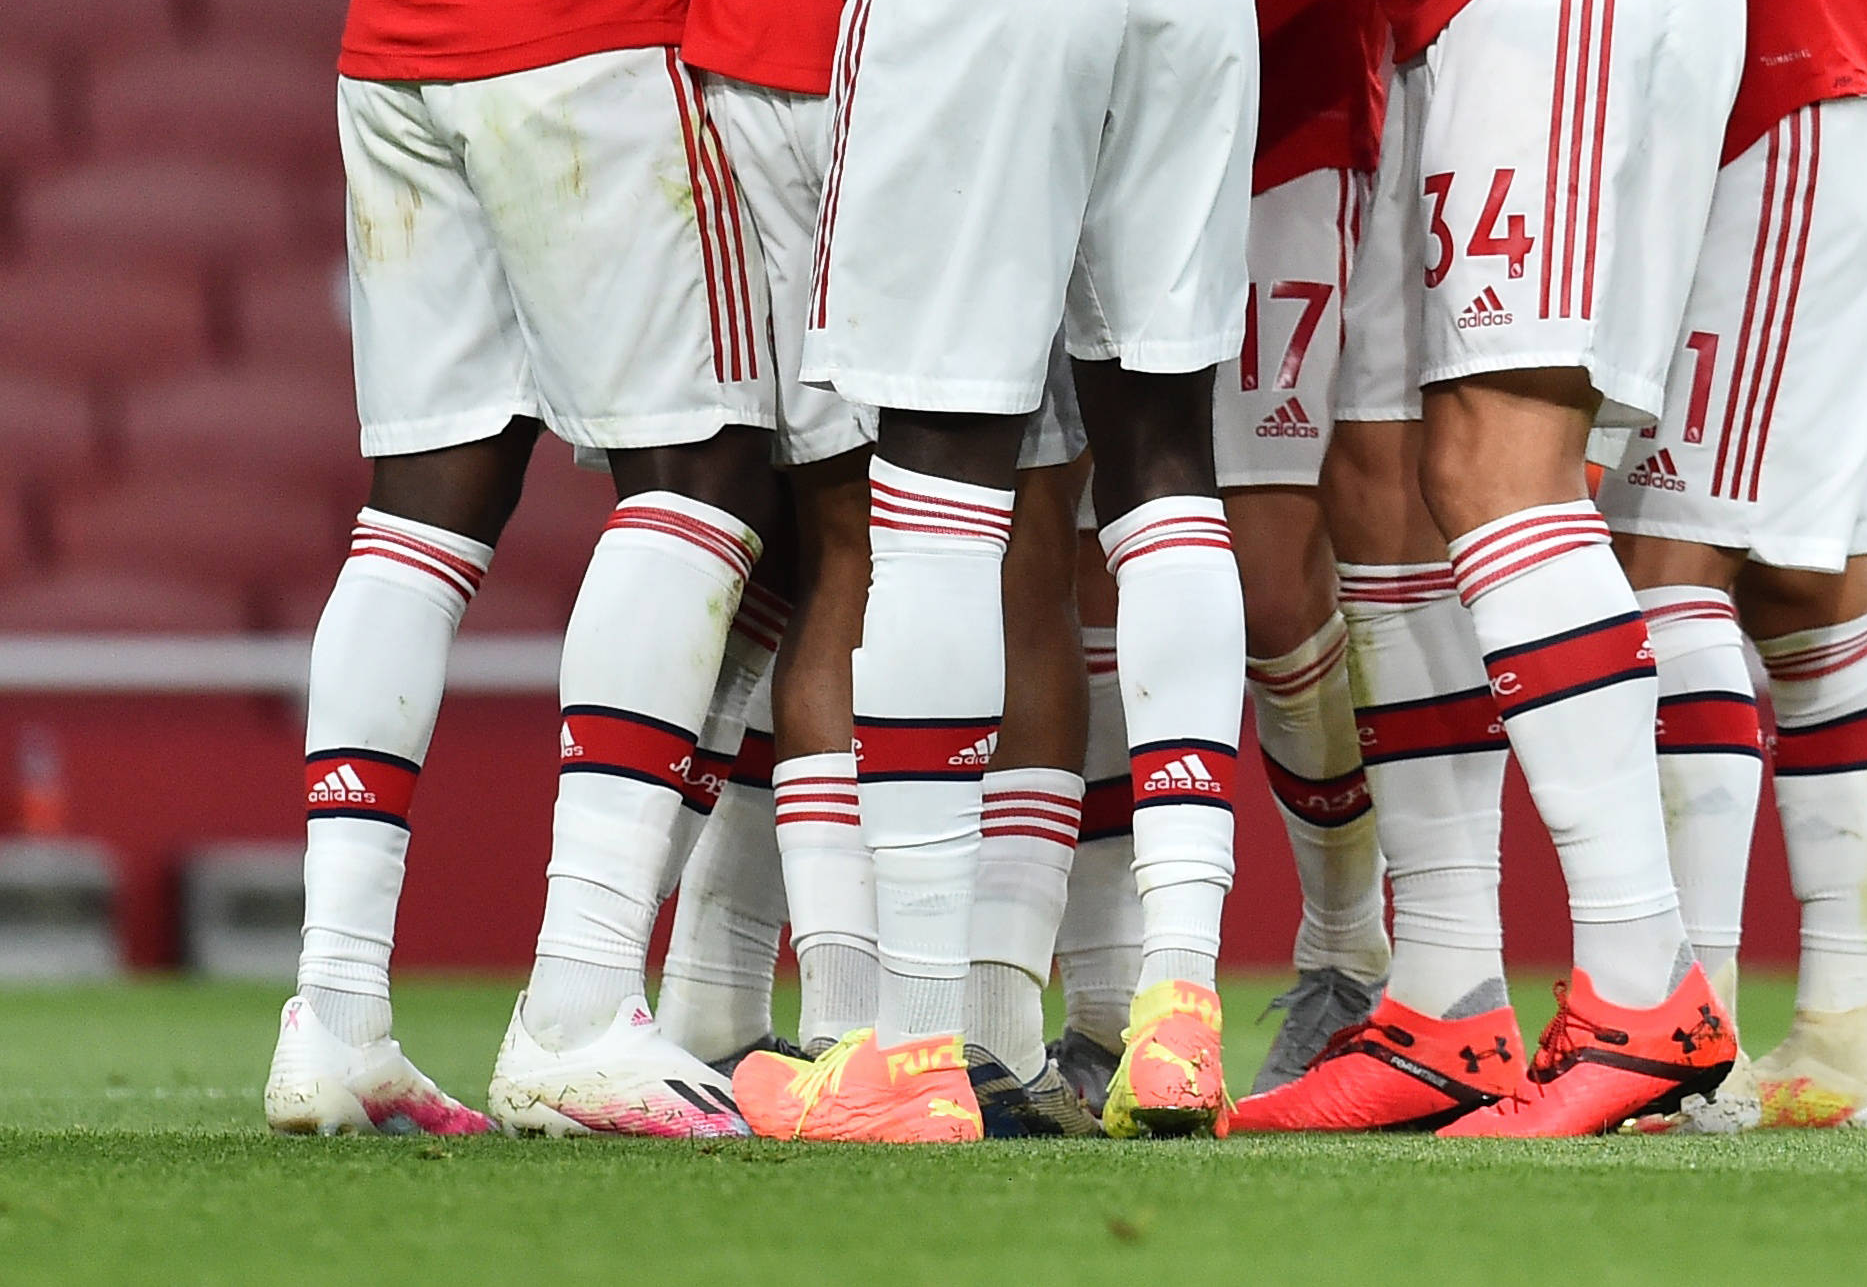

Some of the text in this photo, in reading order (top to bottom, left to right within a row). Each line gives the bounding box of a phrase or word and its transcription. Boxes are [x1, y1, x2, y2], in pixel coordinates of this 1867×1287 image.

[1423, 168, 1536, 289] 34
[1457, 312, 1513, 329] adidas
[1240, 279, 1335, 393] 17
[1255, 421, 1319, 439] adidas
[1627, 470, 1687, 492] adidas
[1143, 777, 1221, 793] adidas
[307, 787, 377, 804] adidas
